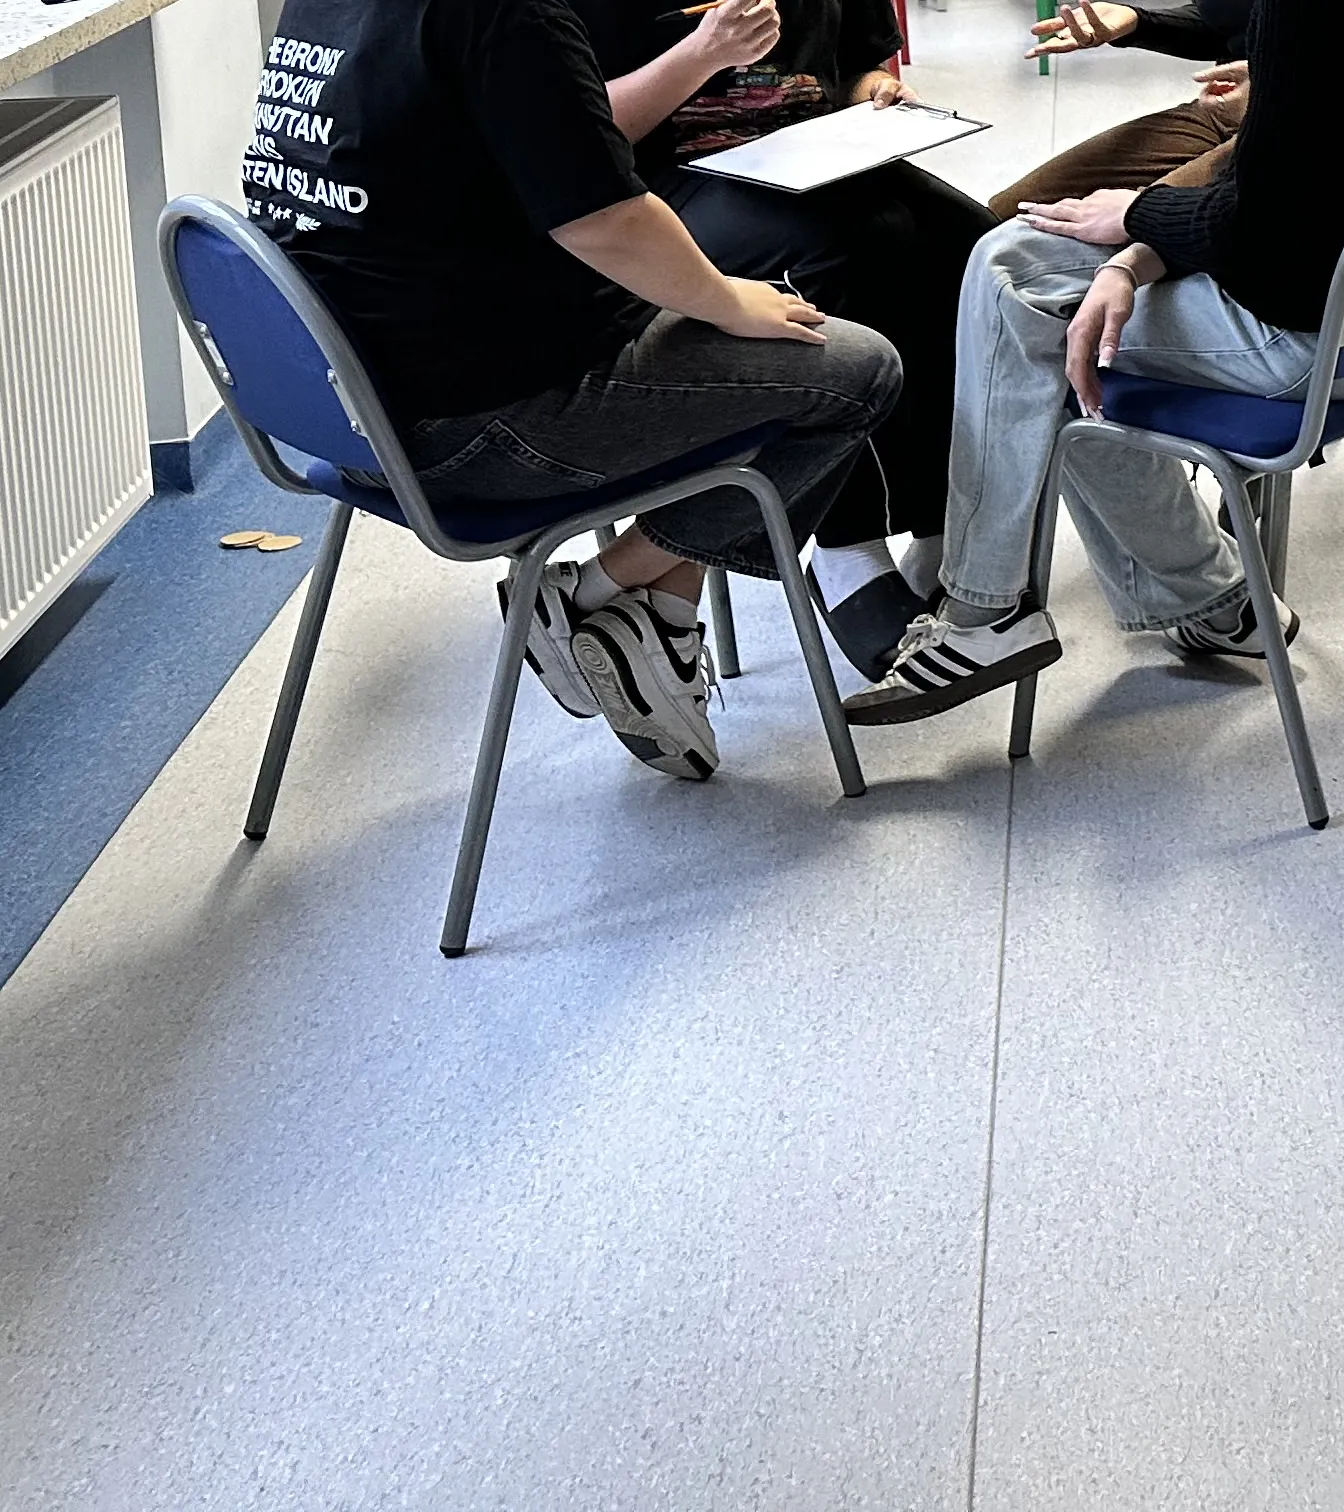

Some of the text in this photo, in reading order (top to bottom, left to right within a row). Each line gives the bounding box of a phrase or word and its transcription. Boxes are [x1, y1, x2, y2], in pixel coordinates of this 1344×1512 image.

[281, 38, 346, 76] BRONX
[258, 69, 326, 107] ROOKLYN
[286, 166, 369, 214] ISLAND
